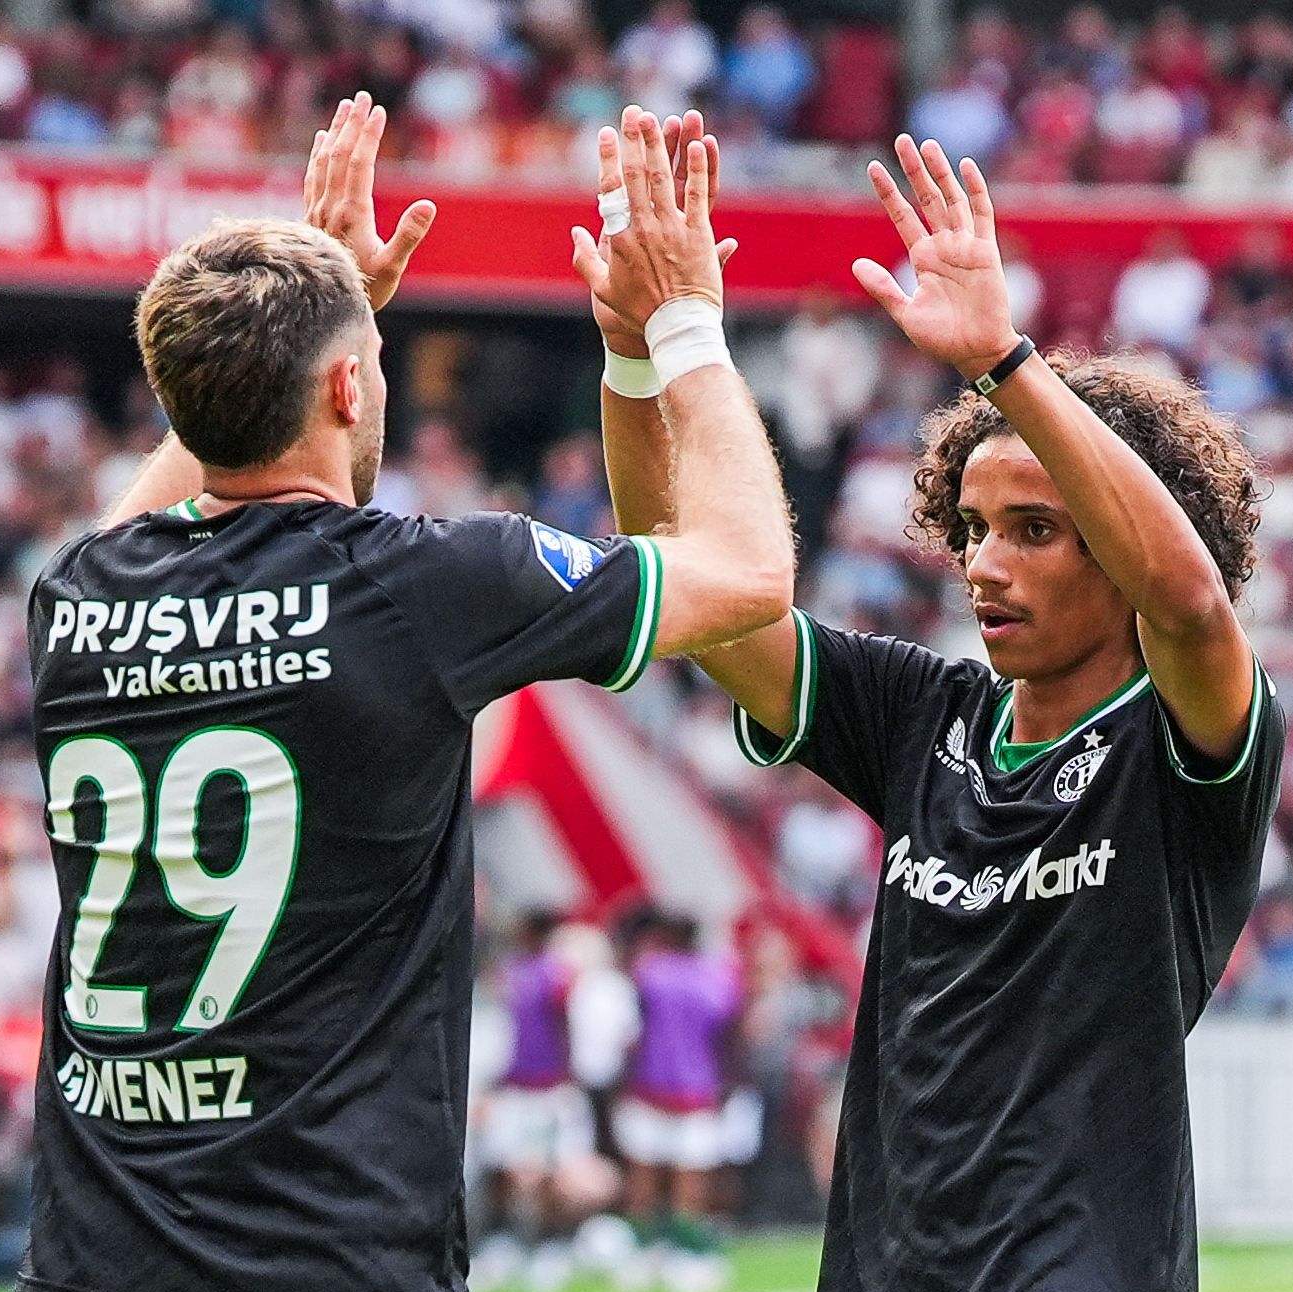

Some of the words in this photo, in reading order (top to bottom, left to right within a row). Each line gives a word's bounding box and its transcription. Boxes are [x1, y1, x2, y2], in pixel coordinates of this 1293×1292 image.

[103, 646, 332, 698] vakanties
[46, 725, 302, 1033] 29
[57, 1050, 254, 1122] GIMENEZ
